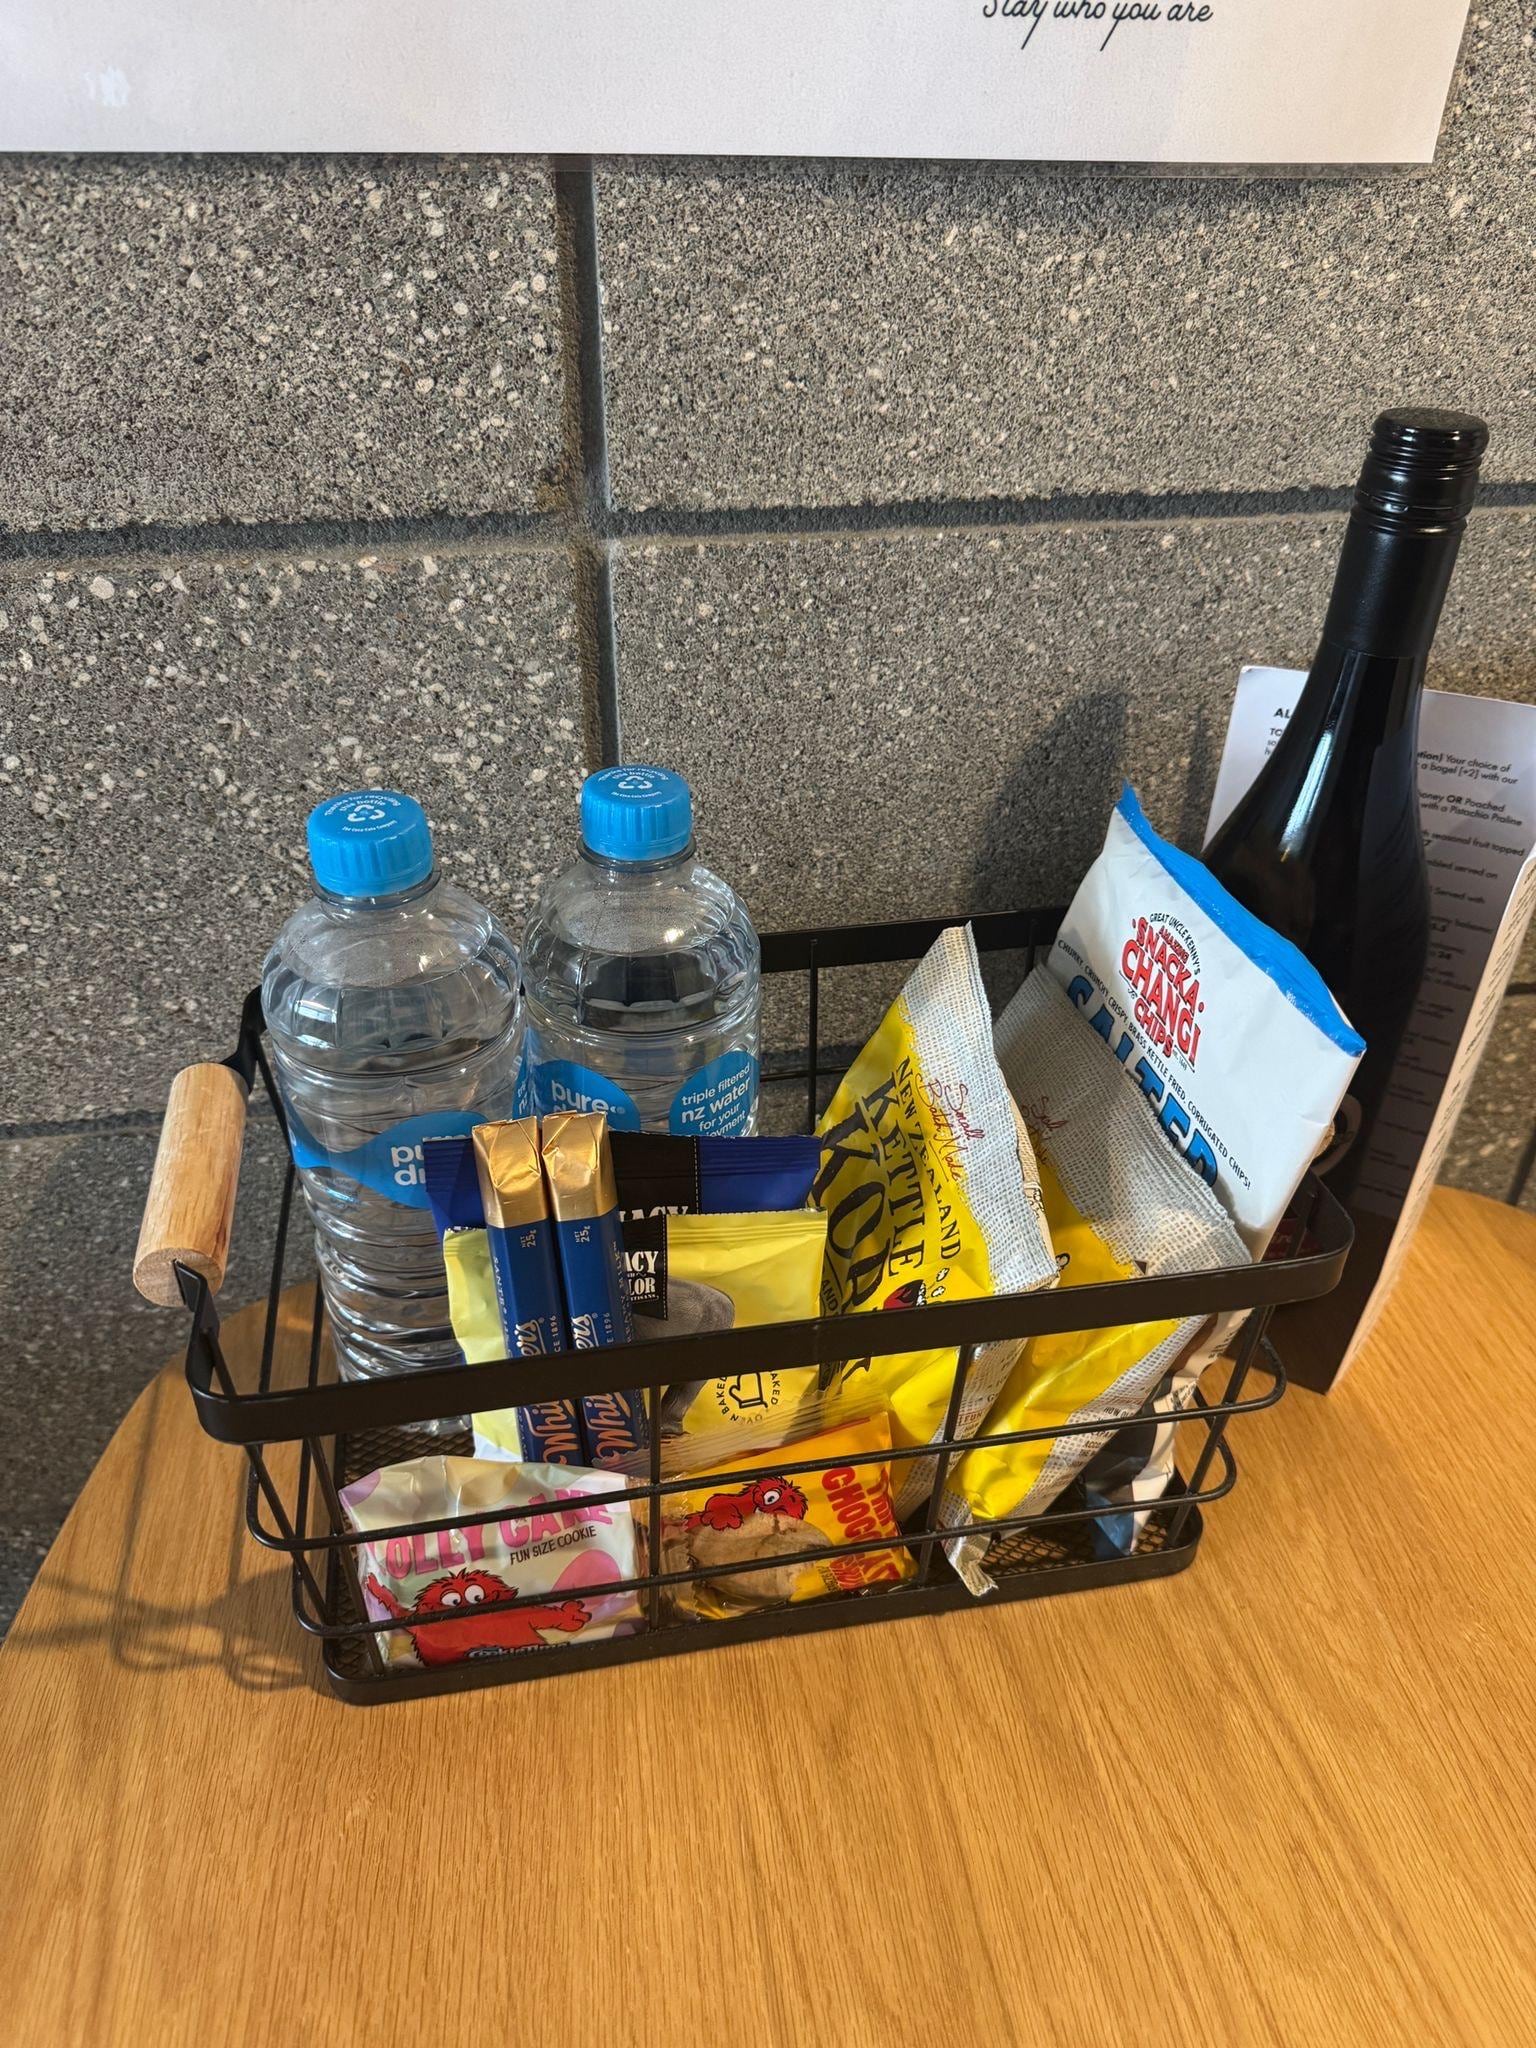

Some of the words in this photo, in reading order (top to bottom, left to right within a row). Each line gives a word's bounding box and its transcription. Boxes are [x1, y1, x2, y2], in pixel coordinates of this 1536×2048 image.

[1053, 0, 1105, 18] who
[1100, 2, 1161, 51] you
[1167, 5, 1214, 21] are
[1416, 751, 1443, 761] tion)
[1446, 754, 1466, 766] Your
[1467, 759, 1498, 771] choice
[1500, 763, 1512, 773] of
[1430, 761, 1457, 775] bagel
[1480, 772, 1500, 782] with
[1501, 776, 1519, 785] our
[1446, 794, 1463, 804] OR
[1464, 798, 1506, 813] Poached
[1449, 805, 1490, 820] Pistachio
[1136, 916, 1201, 1018] SNACKA
[1149, 912, 1170, 923] GREAT
[1168, 917, 1189, 939] UNCLE
[1183, 934, 1201, 976] KENNY'S
[1121, 939, 1202, 1068] CHANGI
[1134, 997, 1174, 1059] CHIPS
[551, 1079, 609, 1113] pure
[681, 1088, 716, 1106] triple
[718, 1061, 750, 1093] filtered
[681, 1105, 706, 1124] nz
[709, 1077, 751, 1114] water
[914, 1072, 954, 1138] Batch
[1128, 1022, 1147, 1049] BRASS
[1146, 1046, 1169, 1078] KETTLE
[1187, 1100, 1229, 1158] CORRUGATED
[1228, 1156, 1251, 1191] CHIPS!
[699, 1118, 717, 1132] for
[718, 1103, 741, 1126] your
[944, 1083, 986, 1141] Small
[391, 1145, 425, 1168] pu
[861, 1069, 926, 1277] KETTLE
[895, 1055, 917, 1120] NEW
[906, 1121, 961, 1260] ZEALAND
[933, 1134, 969, 1182] Made
[809, 1101, 890, 1316] KOR
[628, 1277, 656, 1297] LOR
[770, 1371, 781, 1406] AKED
[510, 1549, 532, 1566] FUN
[533, 1538, 556, 1559] SIZE
[556, 1525, 598, 1548] COOKIE
